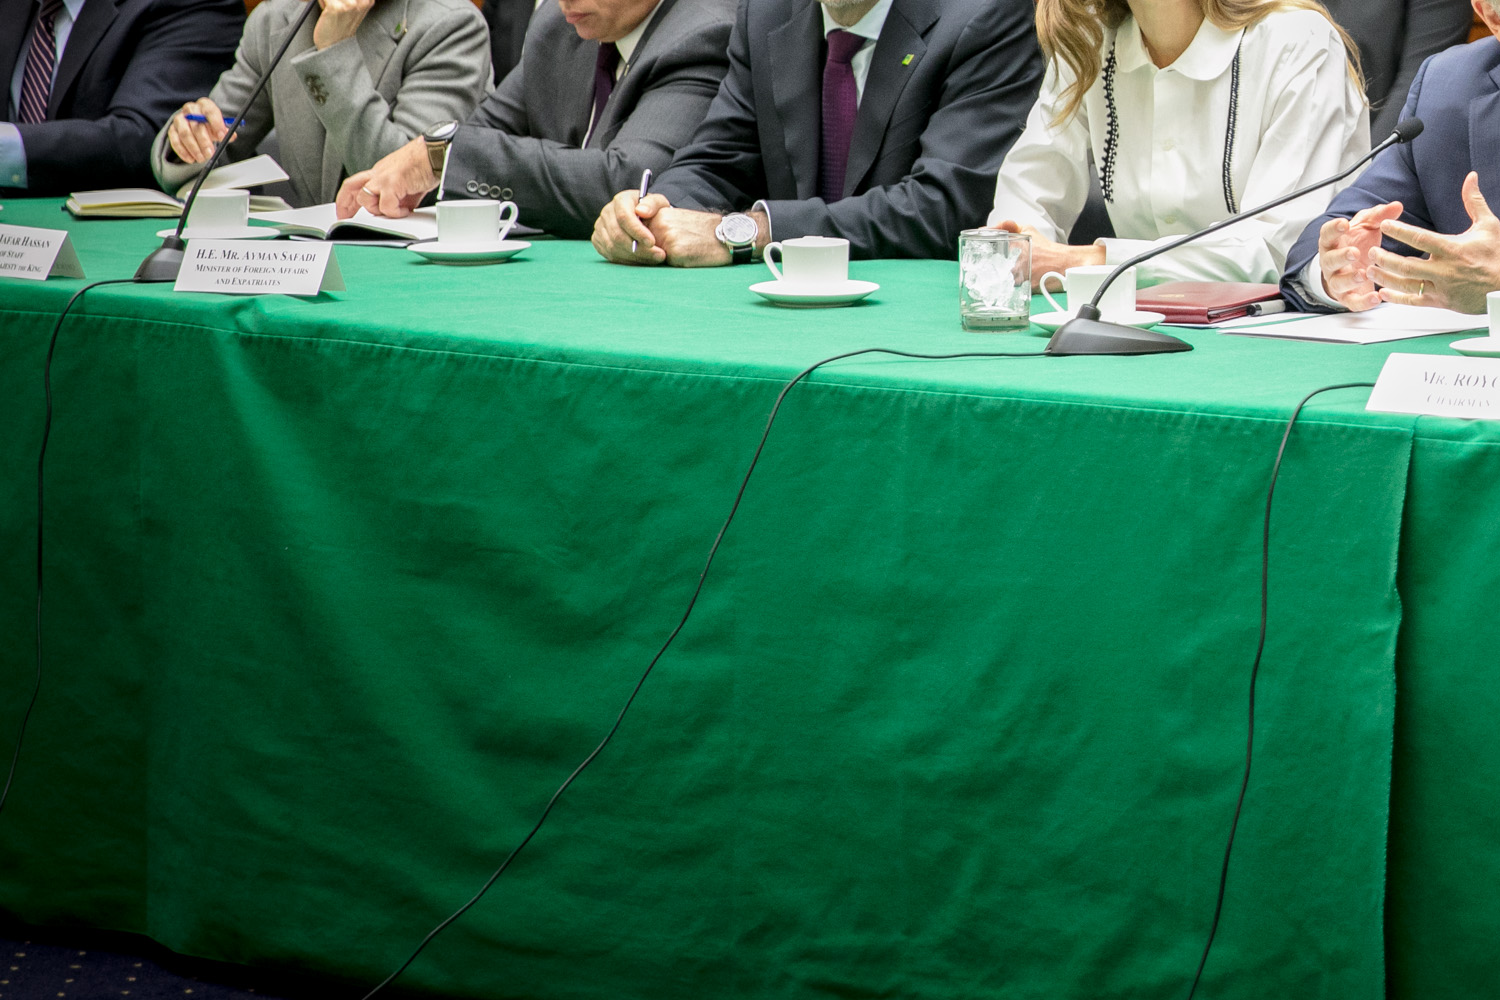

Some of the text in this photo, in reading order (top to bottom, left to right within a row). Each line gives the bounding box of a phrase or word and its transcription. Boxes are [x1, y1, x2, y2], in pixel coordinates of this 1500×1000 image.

[196, 249, 317, 262] H.E. MR. AYMAN SAFADI
[1424, 371, 1448, 386] MR.
